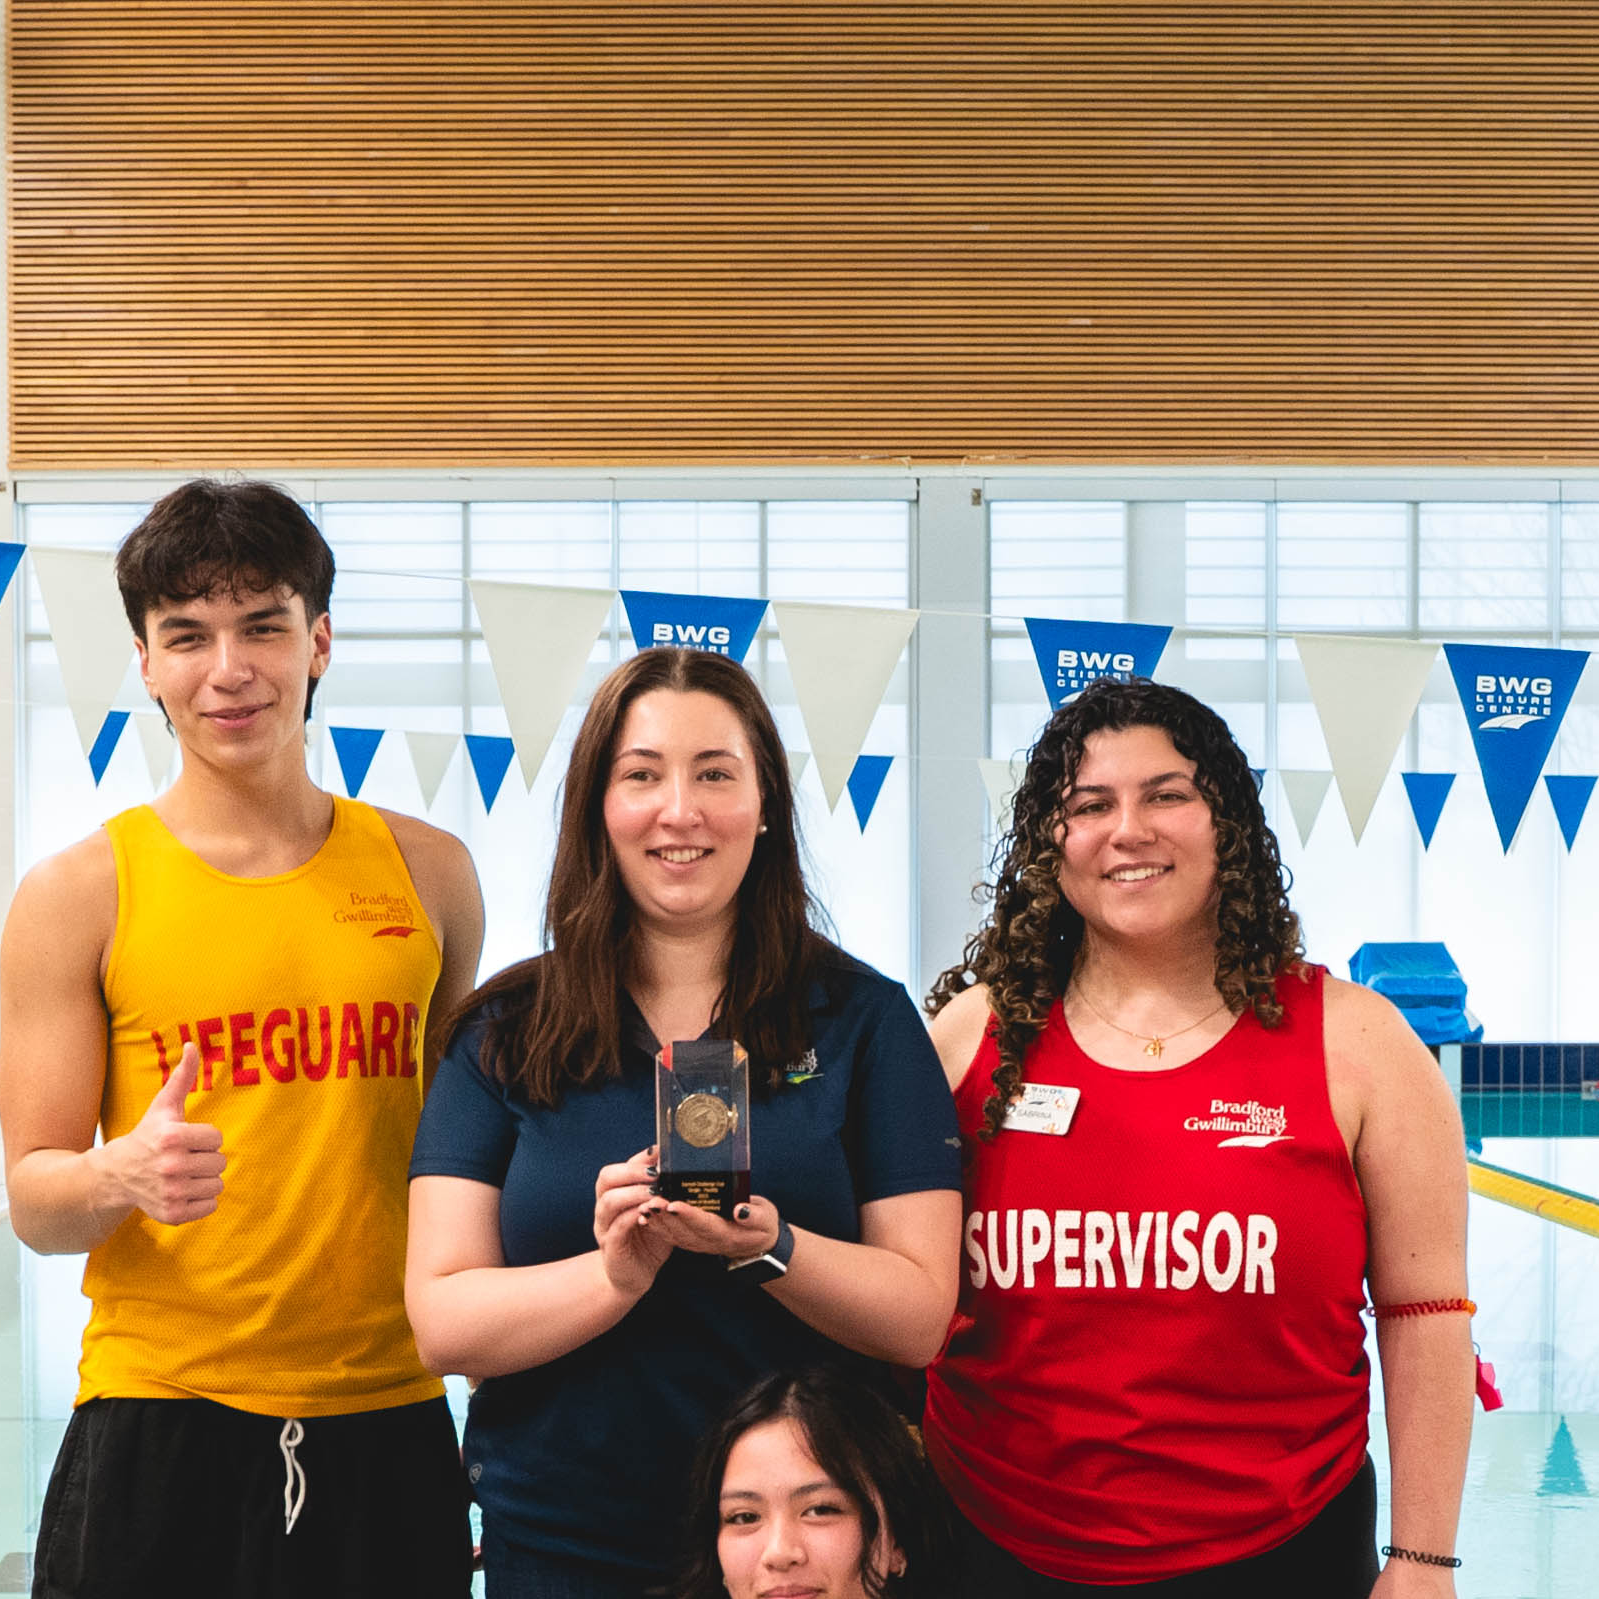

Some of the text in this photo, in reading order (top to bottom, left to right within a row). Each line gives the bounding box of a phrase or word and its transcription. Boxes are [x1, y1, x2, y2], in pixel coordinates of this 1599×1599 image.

[652, 623, 730, 645] BWG
[1058, 649, 1135, 671] BWG
[1476, 675, 1553, 696] BWG
[1475, 694, 1552, 706] LEISURE
[1475, 704, 1551, 716] CENTRE
[349, 892, 409, 908] Bradford
[1210, 1099, 1285, 1120] Bradford
[1183, 1116, 1287, 1137] Gwillimbury
[965, 1208, 1278, 1295] SUPERVISOR
